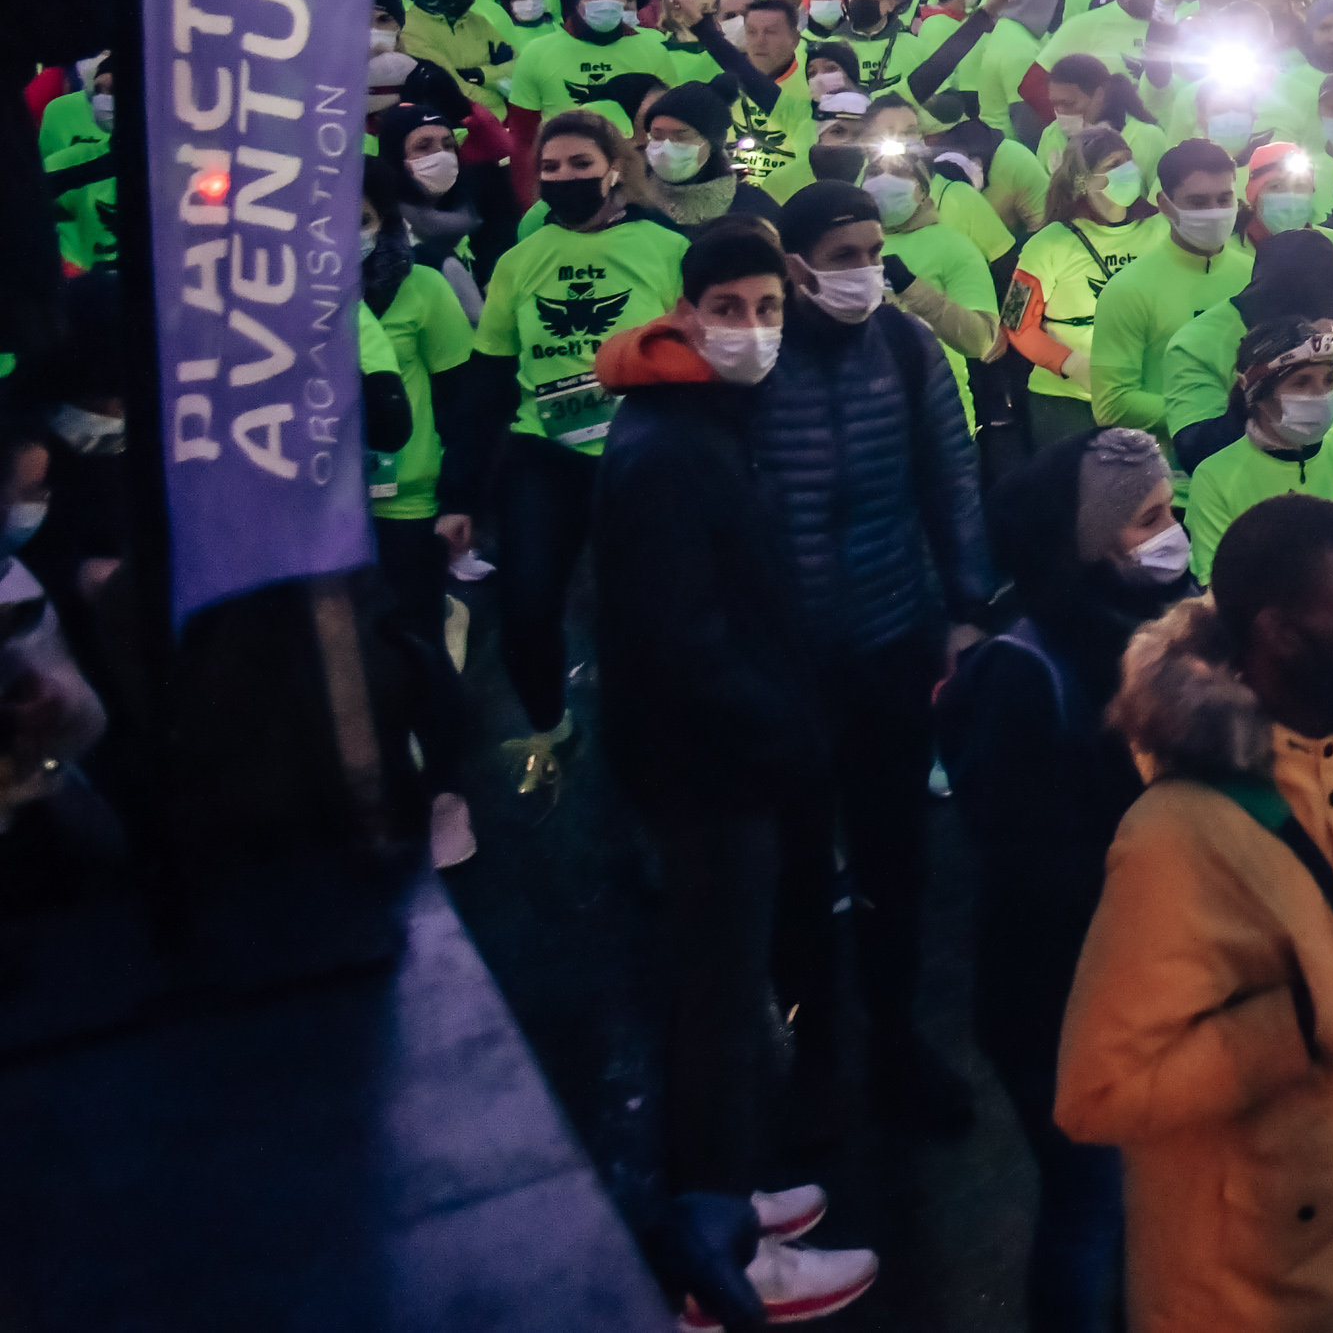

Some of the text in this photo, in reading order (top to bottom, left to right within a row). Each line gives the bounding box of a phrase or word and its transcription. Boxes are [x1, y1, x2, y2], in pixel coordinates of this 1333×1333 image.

[580, 62, 612, 73] Metz
[1105, 254, 1138, 266] Met
[557, 263, 606, 282] Metz
[305, 82, 348, 486] ORGANISATION
